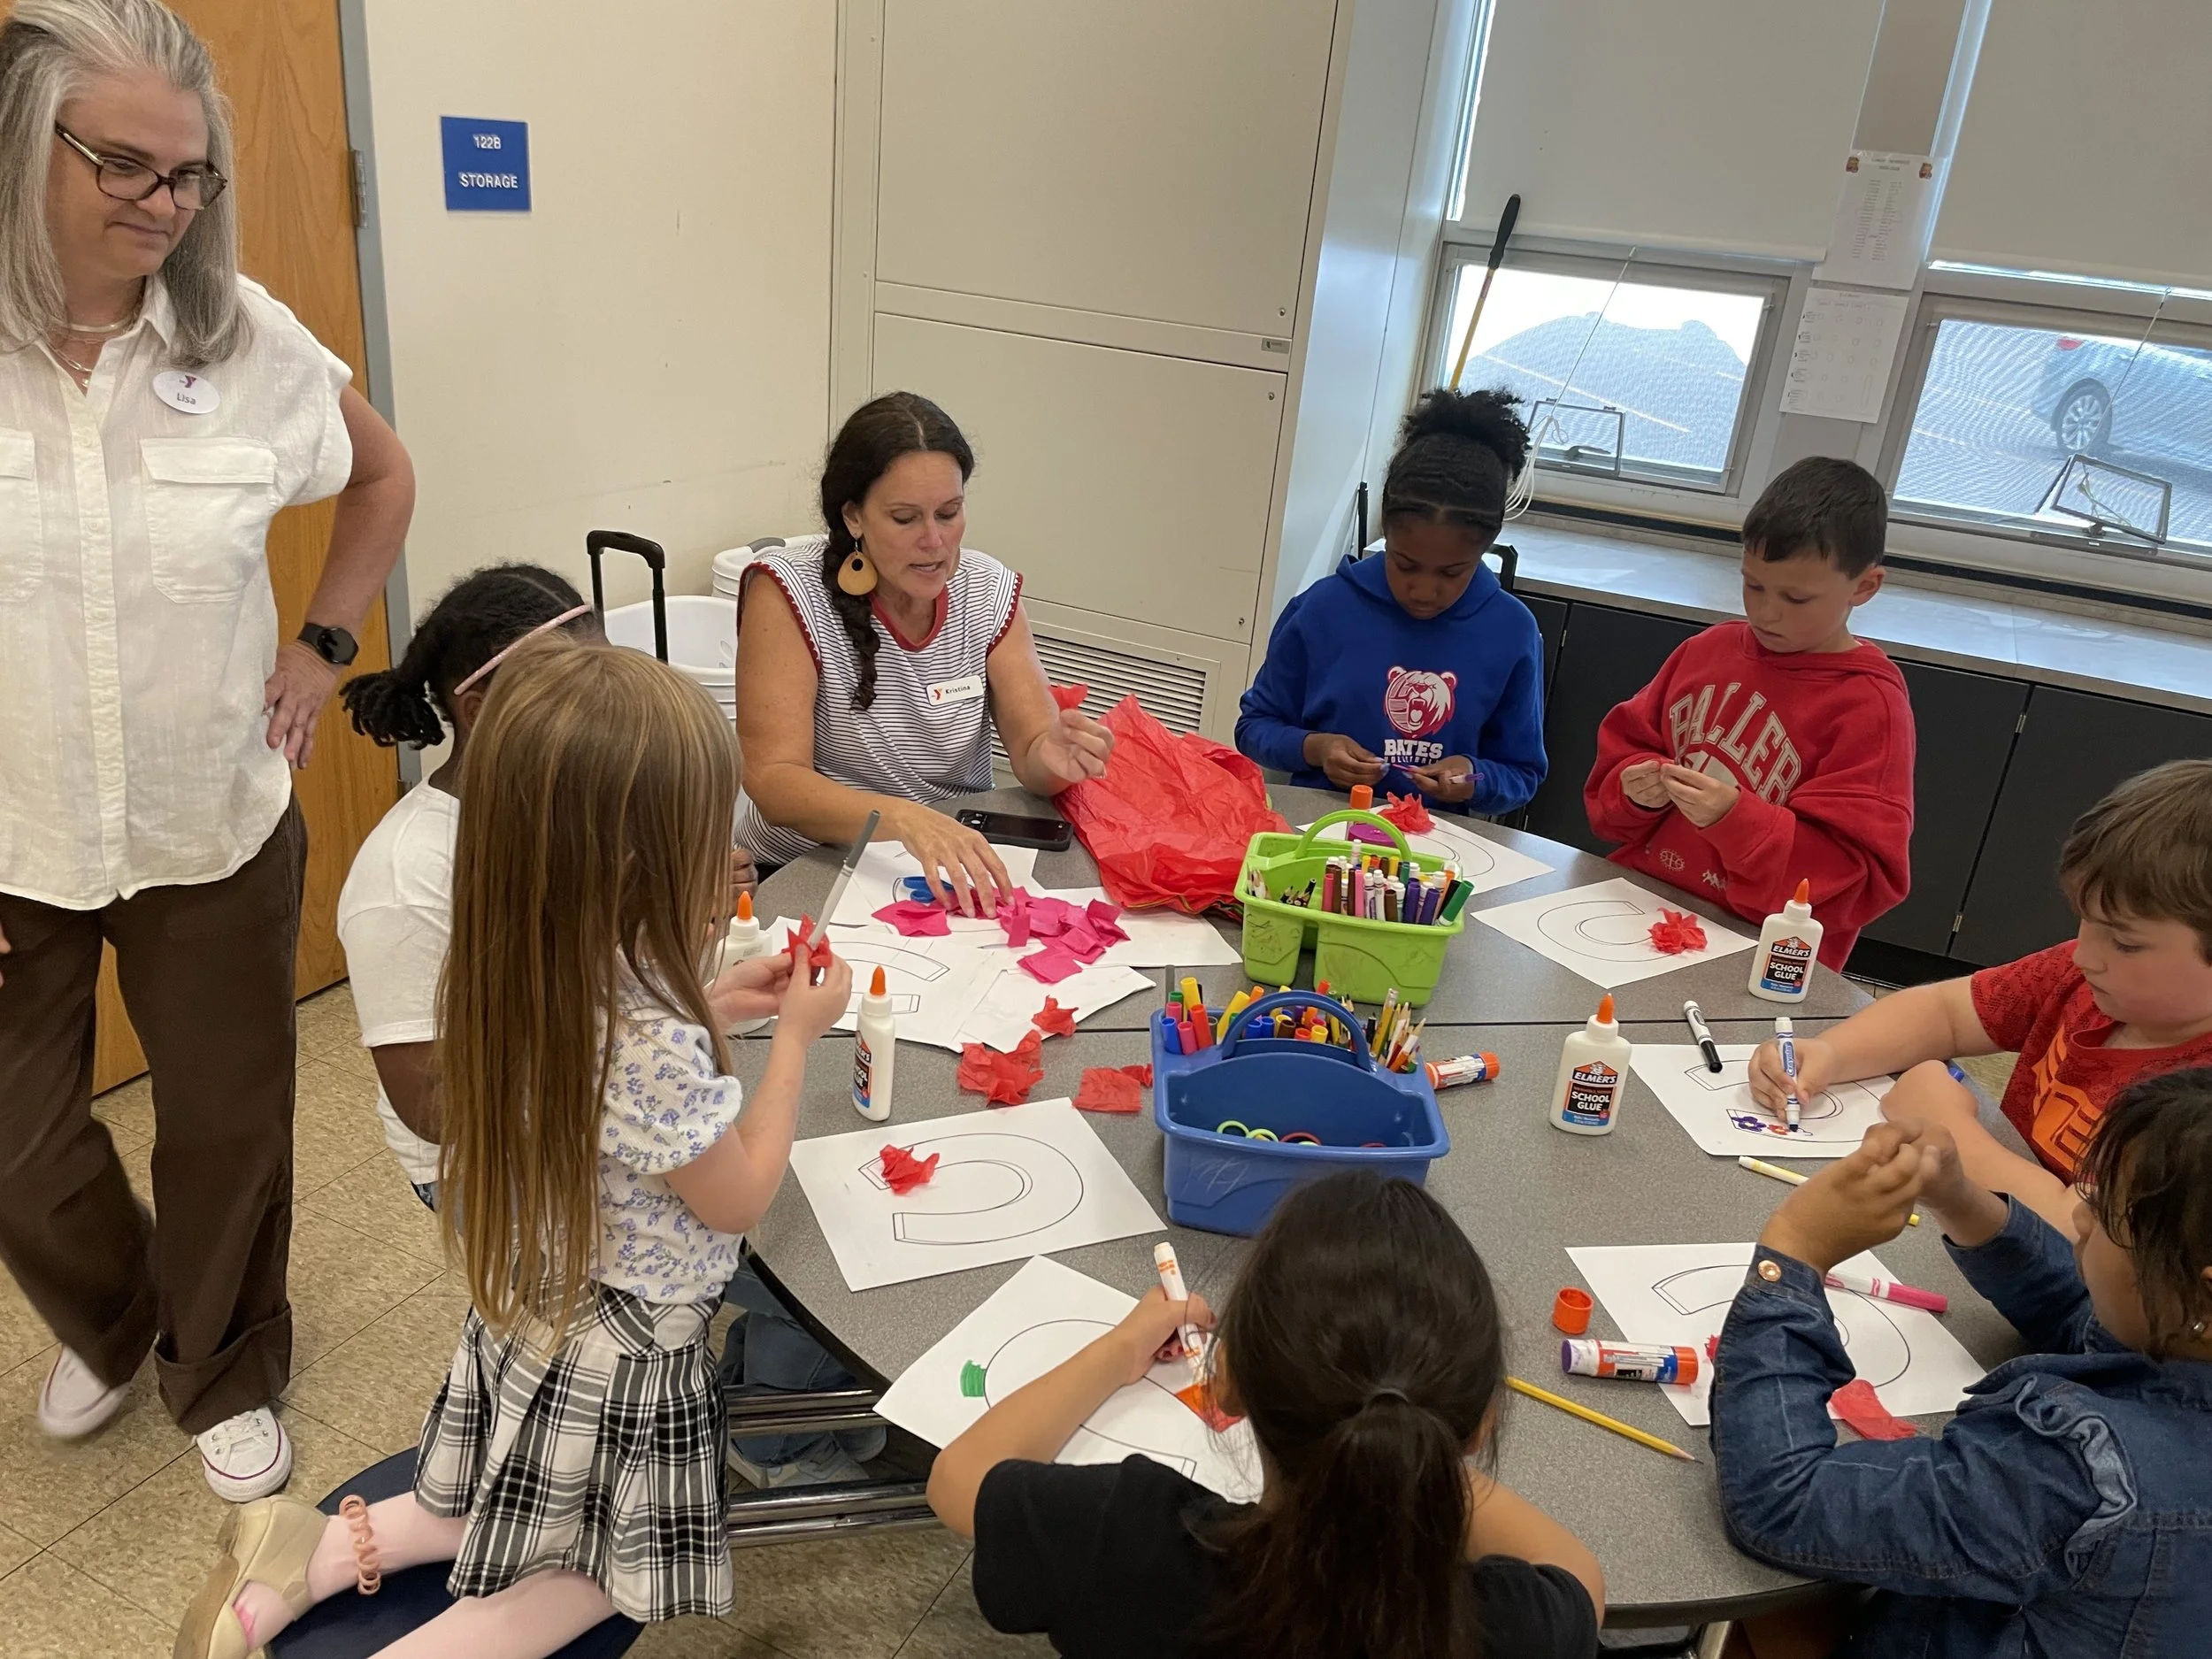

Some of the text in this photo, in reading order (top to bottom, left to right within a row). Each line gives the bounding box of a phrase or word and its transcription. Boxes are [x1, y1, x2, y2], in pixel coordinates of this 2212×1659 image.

[472, 134, 502, 150] 122B
[458, 172, 518, 188] STORAGE
[177, 392, 196, 405] Lisa
[945, 685, 971, 695] Kristina
[1384, 739, 1444, 759] BATES
[1772, 945, 1810, 956] ELMER'S
[1770, 962, 1804, 973] SCHOOL
[1774, 971, 1797, 980] GLUE
[1574, 1071, 1617, 1084] ELMER'S
[1571, 1091, 1610, 1103] SCHOOL
[1577, 1102, 1603, 1111] GLUE
